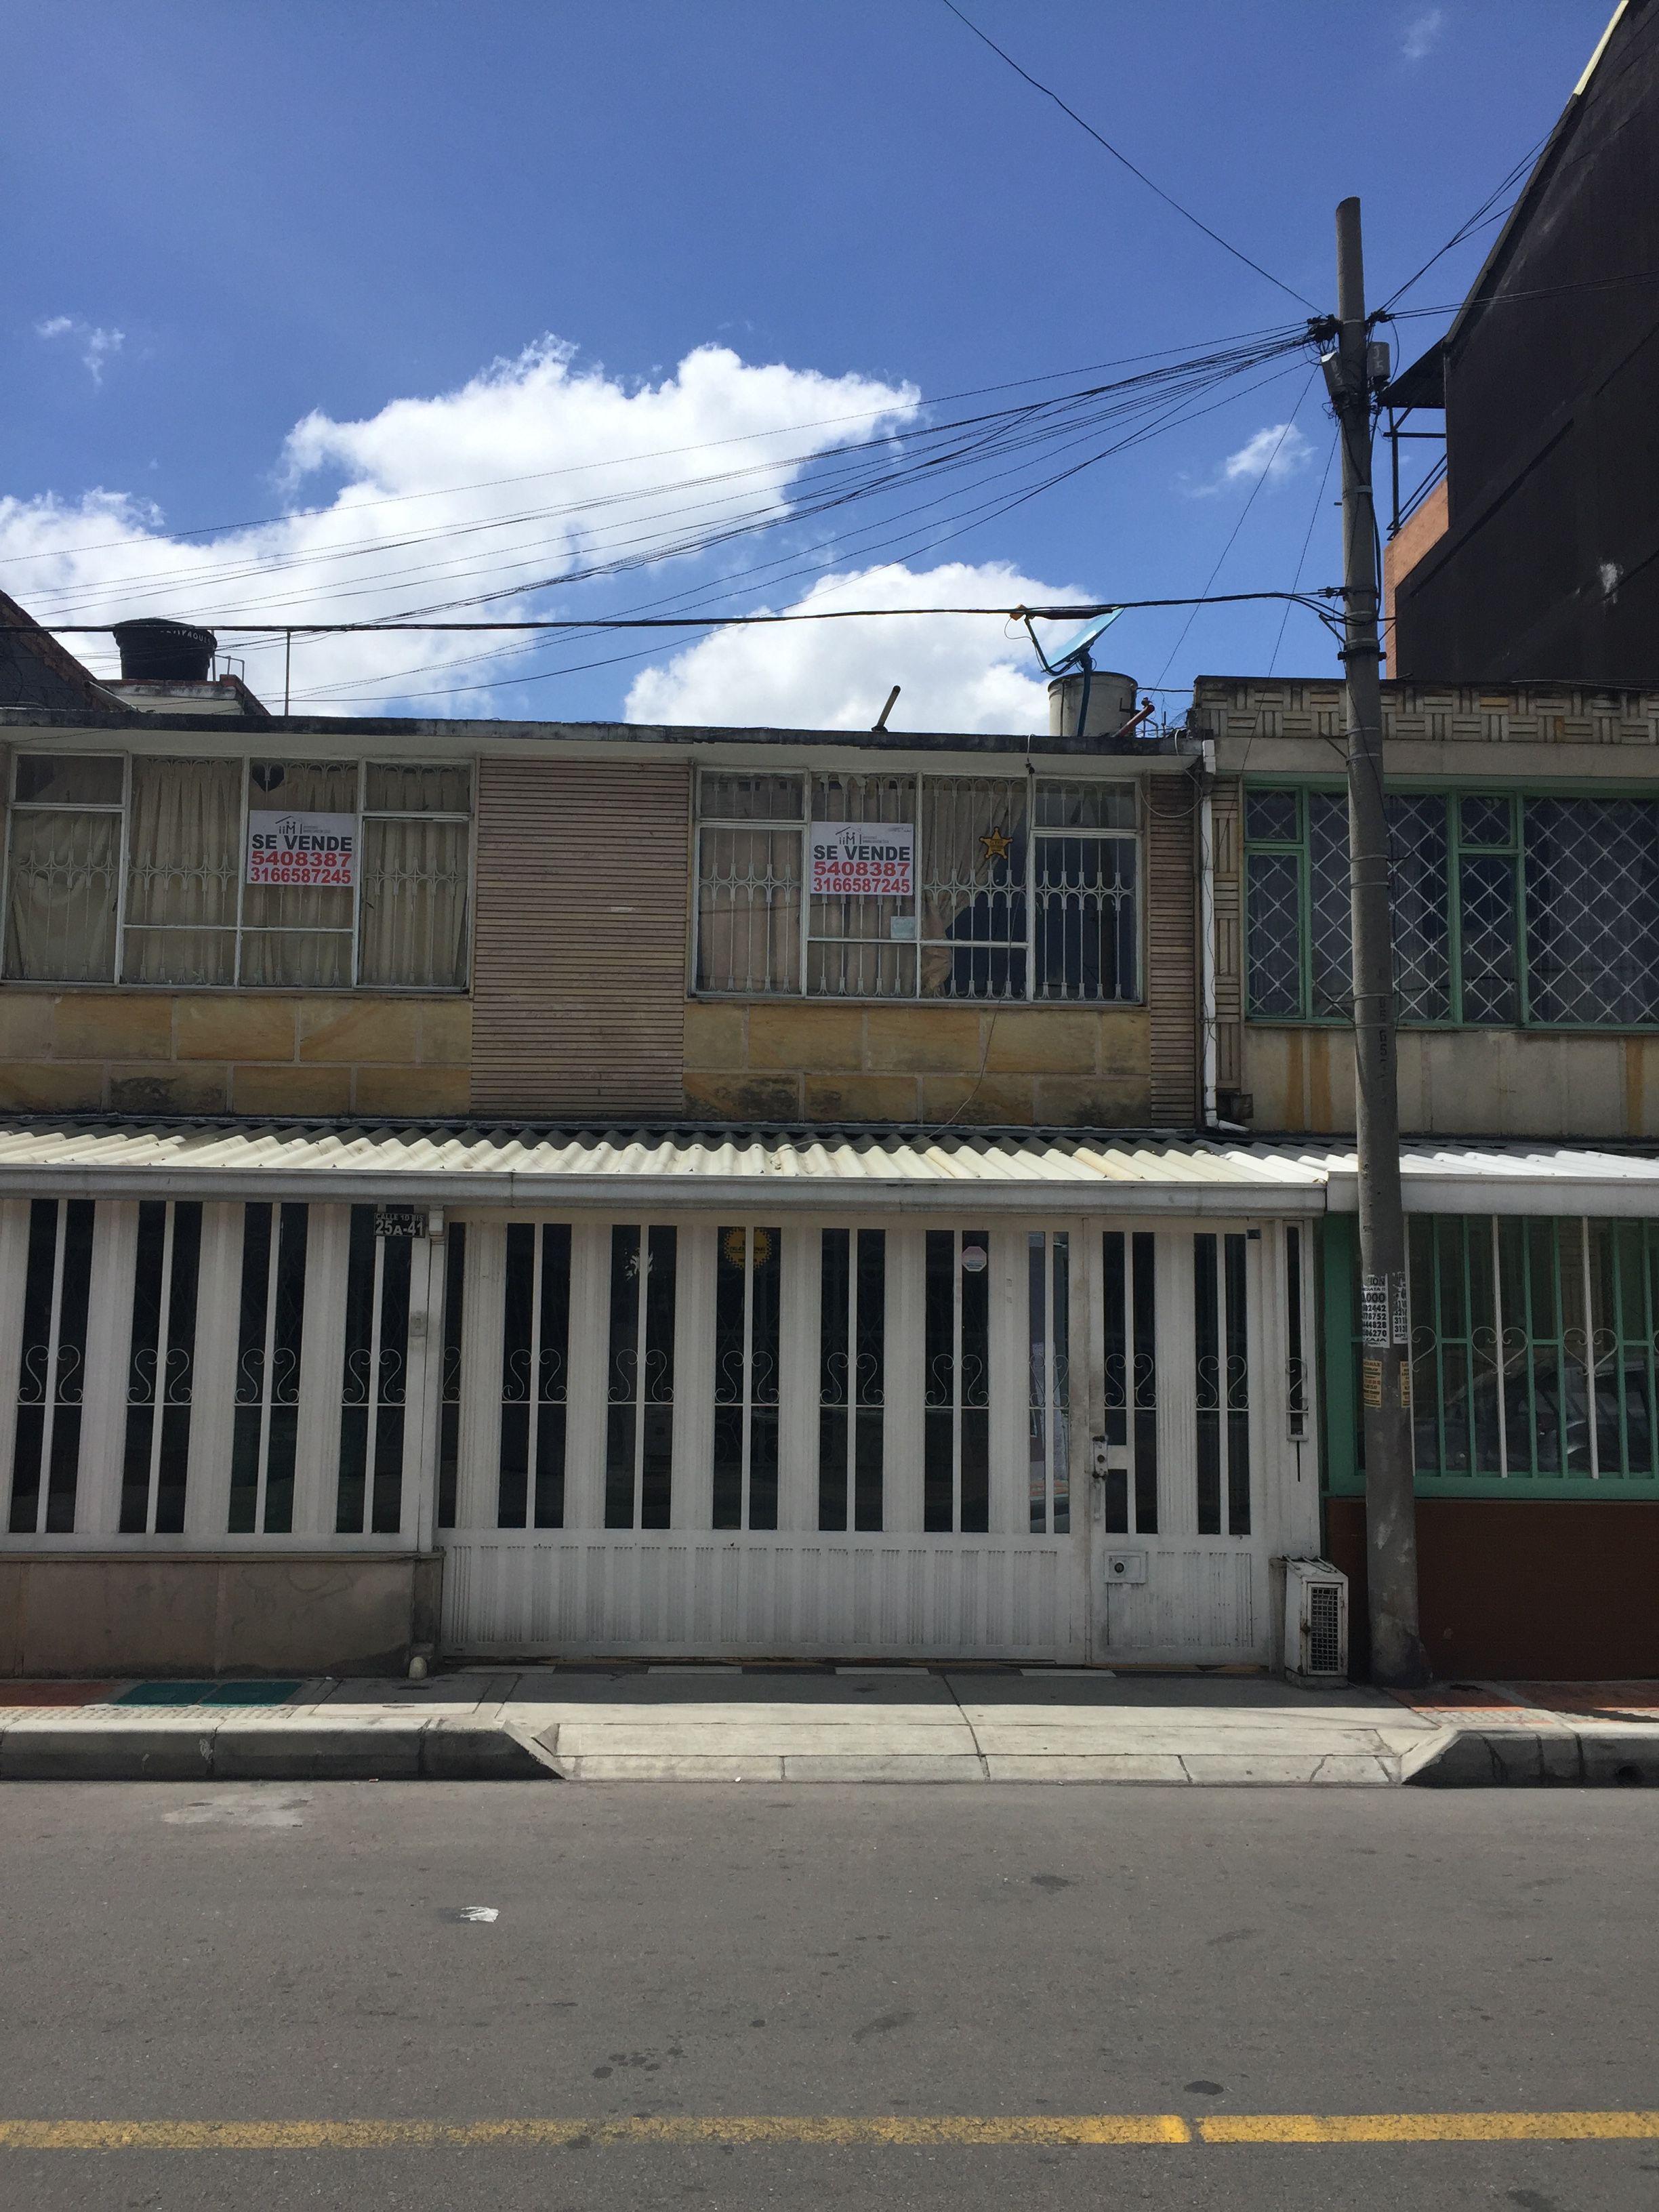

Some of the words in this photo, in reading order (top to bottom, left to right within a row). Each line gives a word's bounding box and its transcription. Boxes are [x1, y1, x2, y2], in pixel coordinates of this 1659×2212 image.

[251, 834, 277, 849] SE
[284, 835, 352, 851] VENDE
[251, 851, 352, 867] 5408387
[813, 845, 838, 860] SE
[846, 846, 910, 861] VENDE
[250, 867, 352, 884] 3166587245
[813, 861, 910, 877] 5408387
[813, 877, 910, 893] 3166587245
[375, 1219, 423, 1236] 25A-41
